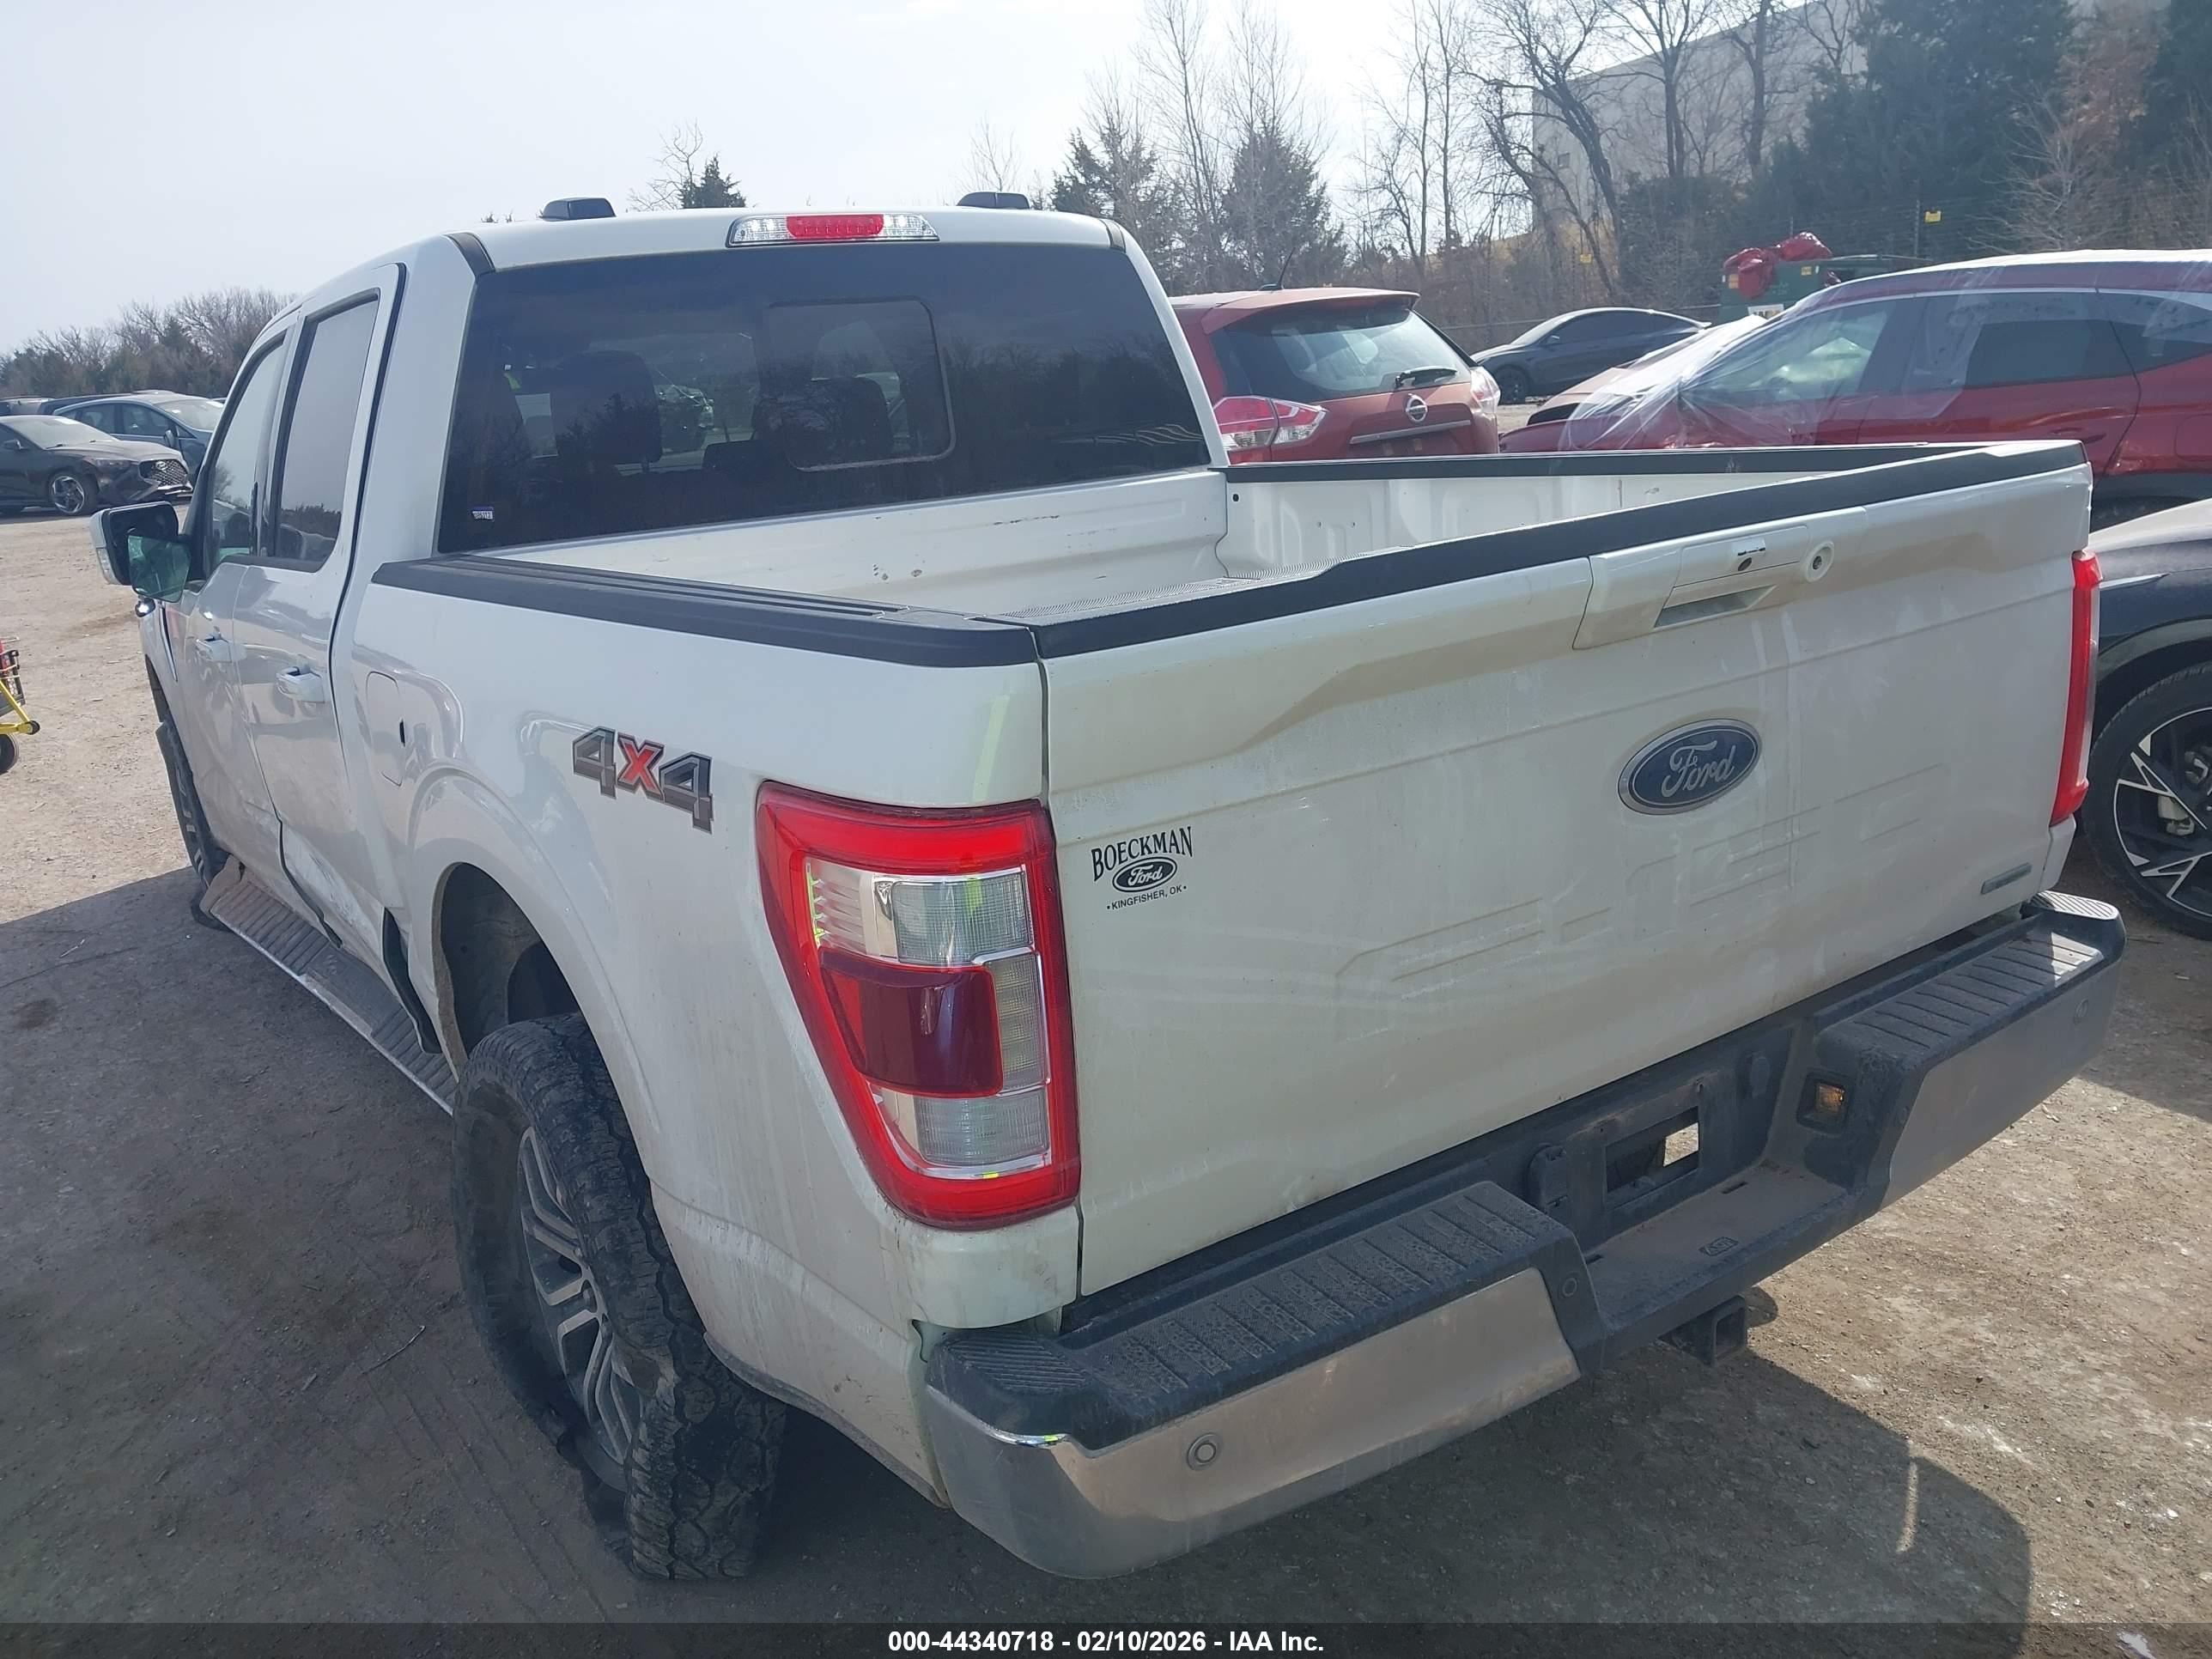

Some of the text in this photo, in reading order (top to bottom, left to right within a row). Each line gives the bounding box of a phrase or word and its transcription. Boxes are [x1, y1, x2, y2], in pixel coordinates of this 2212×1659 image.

[1662, 740, 1736, 798] Ford
[1091, 825, 1193, 883] BOECKMAN
[1127, 864, 1164, 886] Ford
[1111, 884, 1182, 910] KINGFISHER, OK
